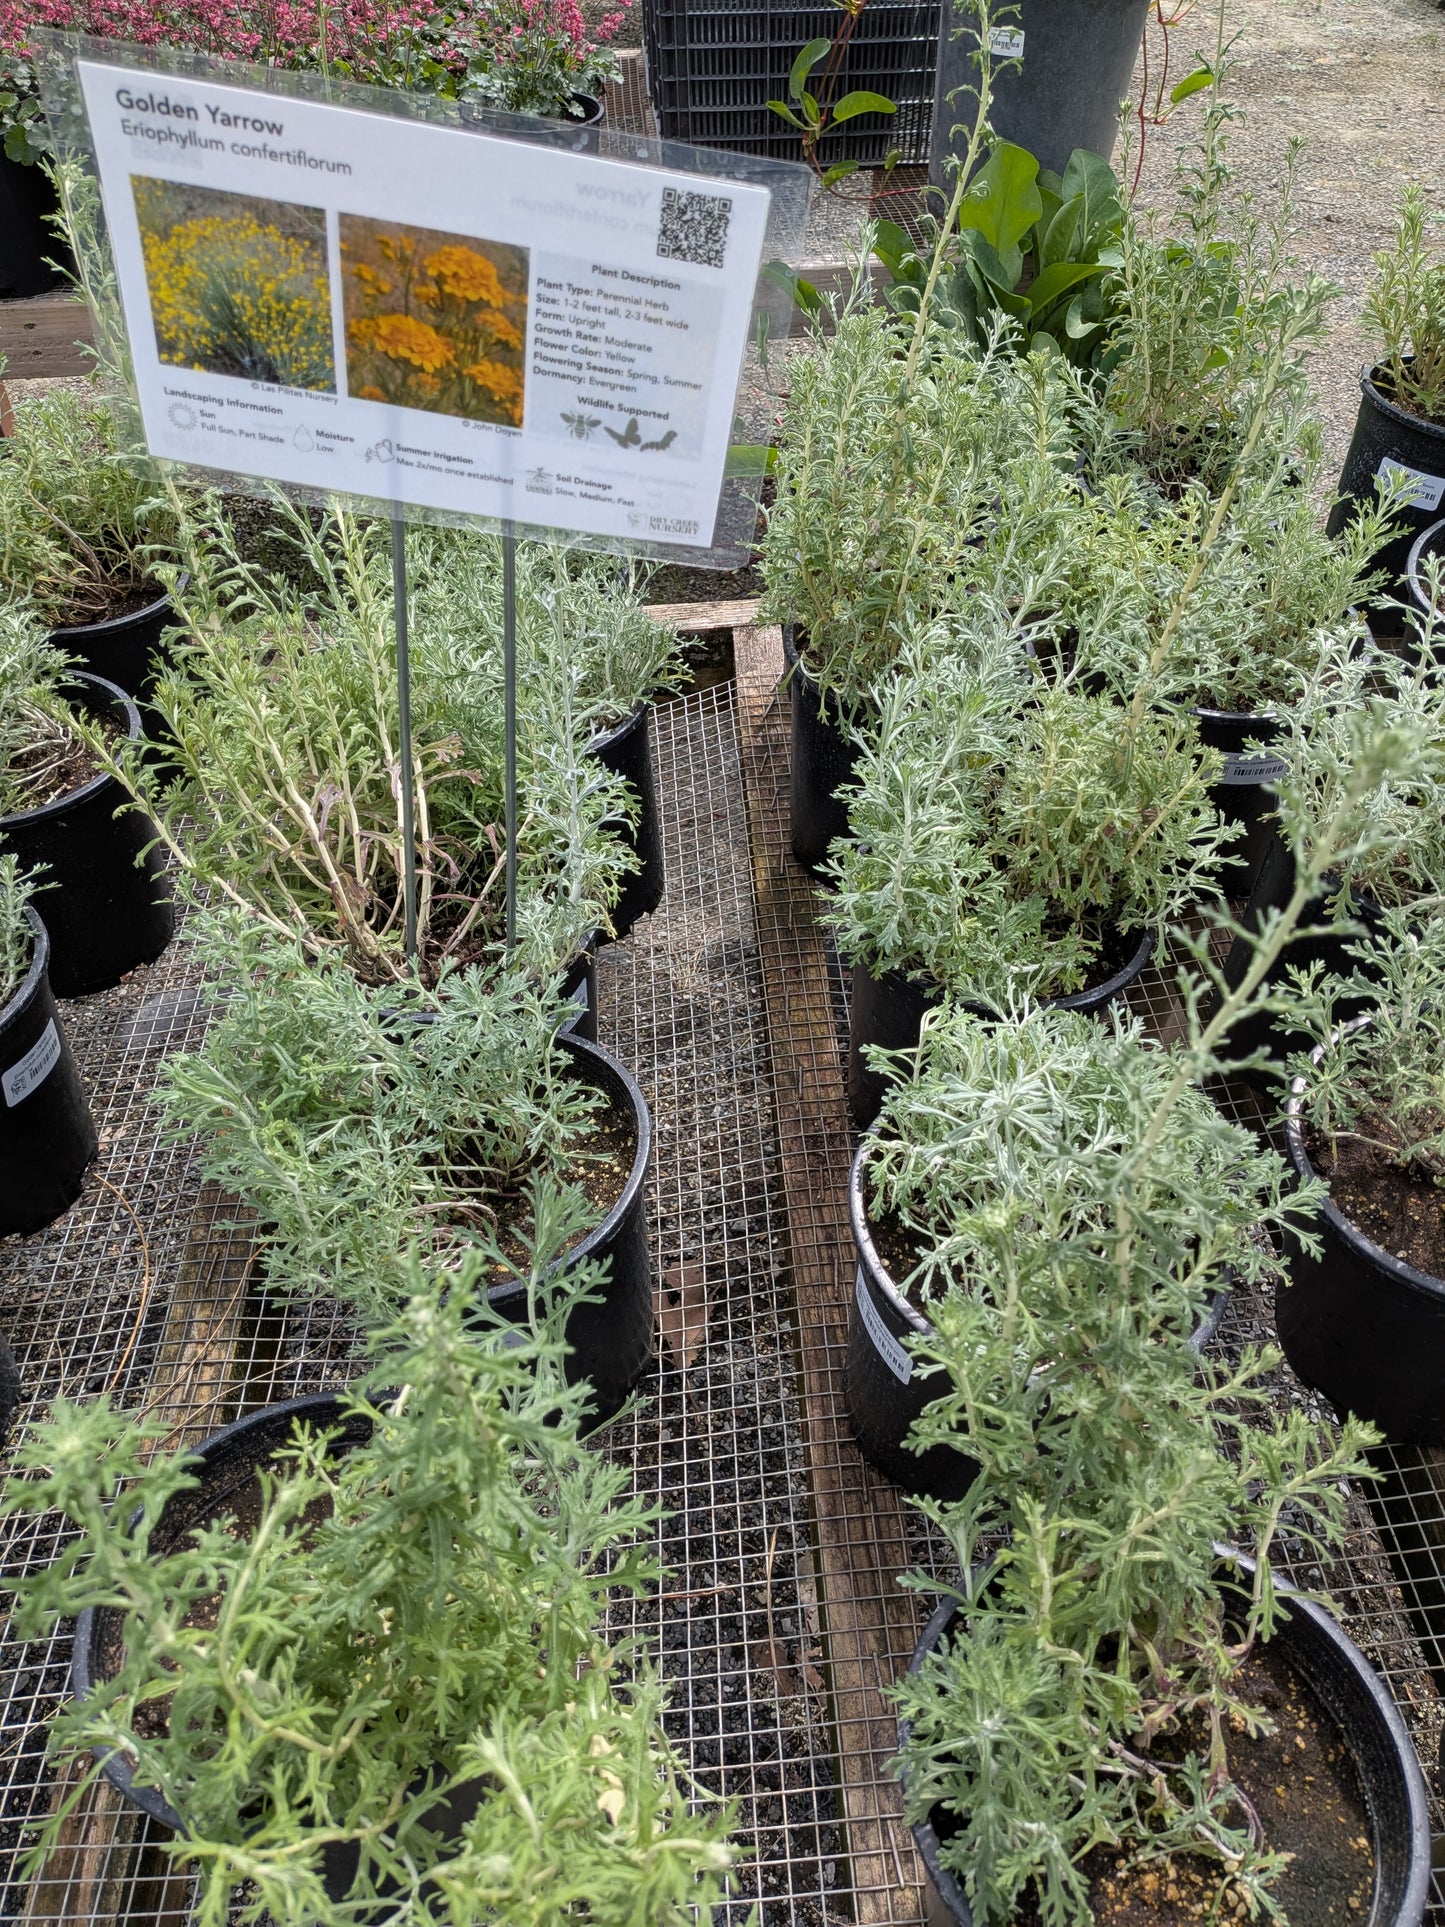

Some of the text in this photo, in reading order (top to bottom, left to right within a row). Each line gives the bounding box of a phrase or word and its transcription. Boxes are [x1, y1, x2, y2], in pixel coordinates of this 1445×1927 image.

[116, 90, 283, 136] Golden Yarrow
[121, 119, 352, 175] Eriophyllum confertiflorum
[592, 265, 680, 291] Plant Description
[537, 278, 669, 312] Plant Type: Perennial Herb
[536, 294, 689, 330] Size: 1-2 feet tall, 2-3 feet wide
[536, 308, 606, 330] Form: Upright
[535, 323, 652, 352] Growth Rate: Moderate
[534, 338, 636, 364] Flower Color: Yellow
[533, 366, 637, 393] Dormancy: Evergreen
[534, 352, 702, 391] Flowering Season: Spring, Summer
[163, 386, 283, 415] Landscaping Information
[261, 384, 275, 393] Las
[278, 386, 302, 398] Pilitas
[305, 392, 338, 405] Nursery
[200, 410, 215, 419] Sun
[577, 396, 670, 421] Wildlife Supported
[201, 423, 284, 444] Full Sun, Part Shade
[316, 429, 354, 443] Moisture
[472, 423, 493, 433] John
[495, 426, 522, 438] Doyen
[317, 444, 334, 453] Low
[396, 444, 473, 465] Summer Irrigation
[396, 457, 513, 485] Max 2x/mo once established
[556, 474, 572, 483] Soil
[574, 477, 612, 490] Drainage
[555, 487, 634, 506] Slow, Medium, Fast
[649, 523, 698, 535] NURSERY
